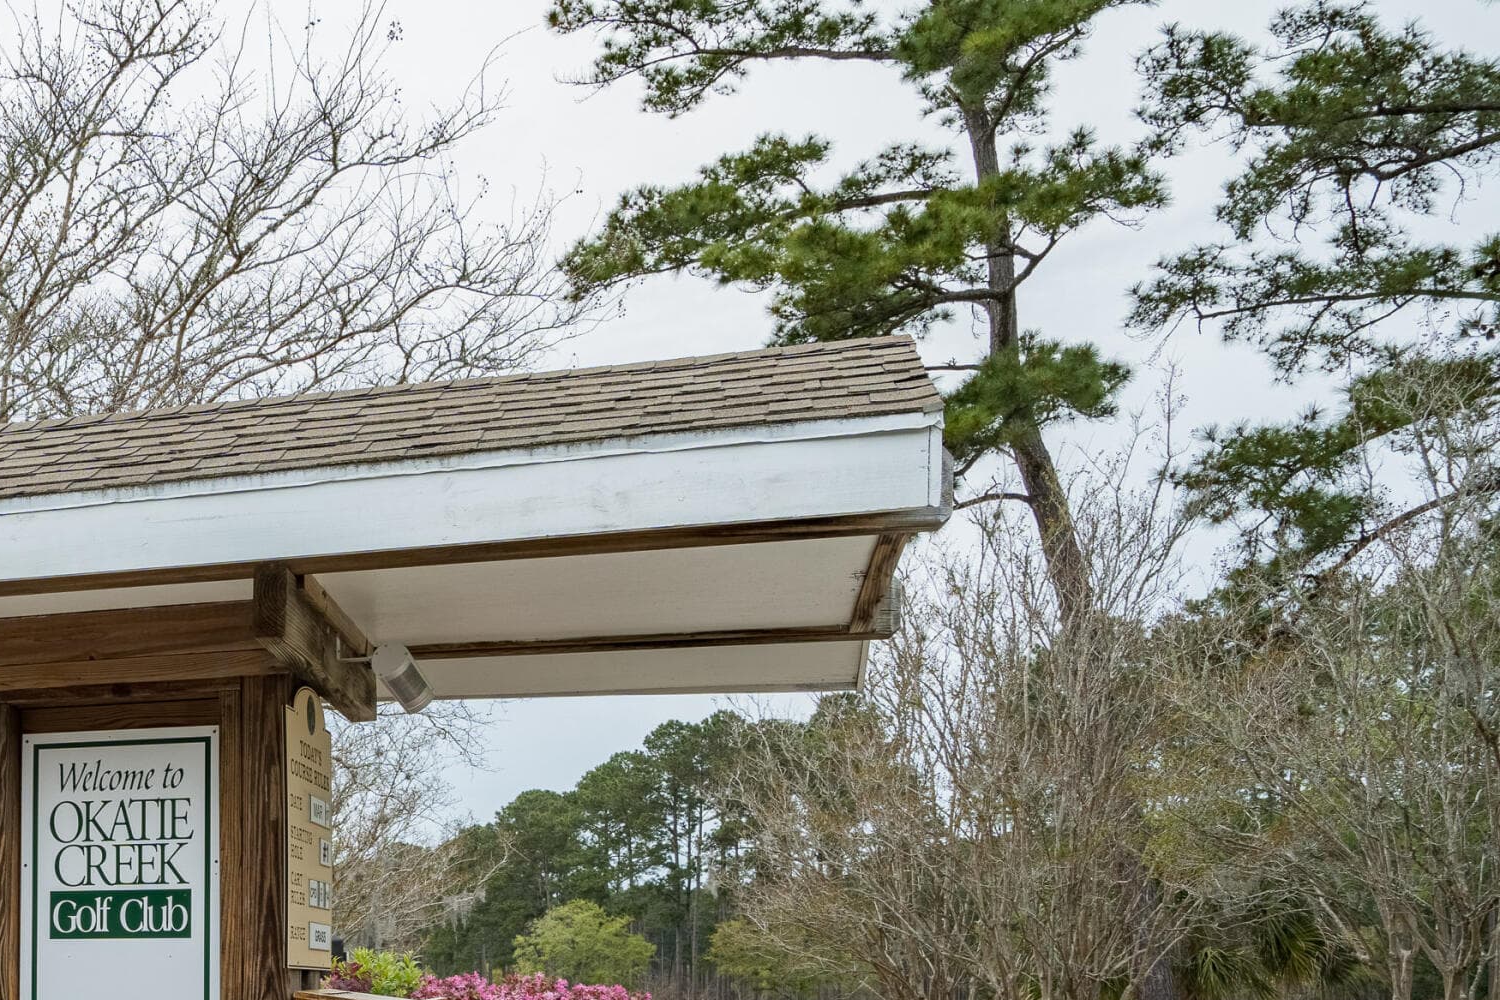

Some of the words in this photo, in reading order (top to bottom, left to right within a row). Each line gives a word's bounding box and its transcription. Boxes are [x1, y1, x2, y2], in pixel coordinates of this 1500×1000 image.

[58, 759, 155, 793] Welcome
[163, 764, 184, 789] to
[291, 758, 313, 784] COURSE
[49, 797, 194, 843] OKATIE
[54, 842, 190, 887] CREEK
[52, 896, 112, 934] Golf
[119, 895, 189, 933] Club
